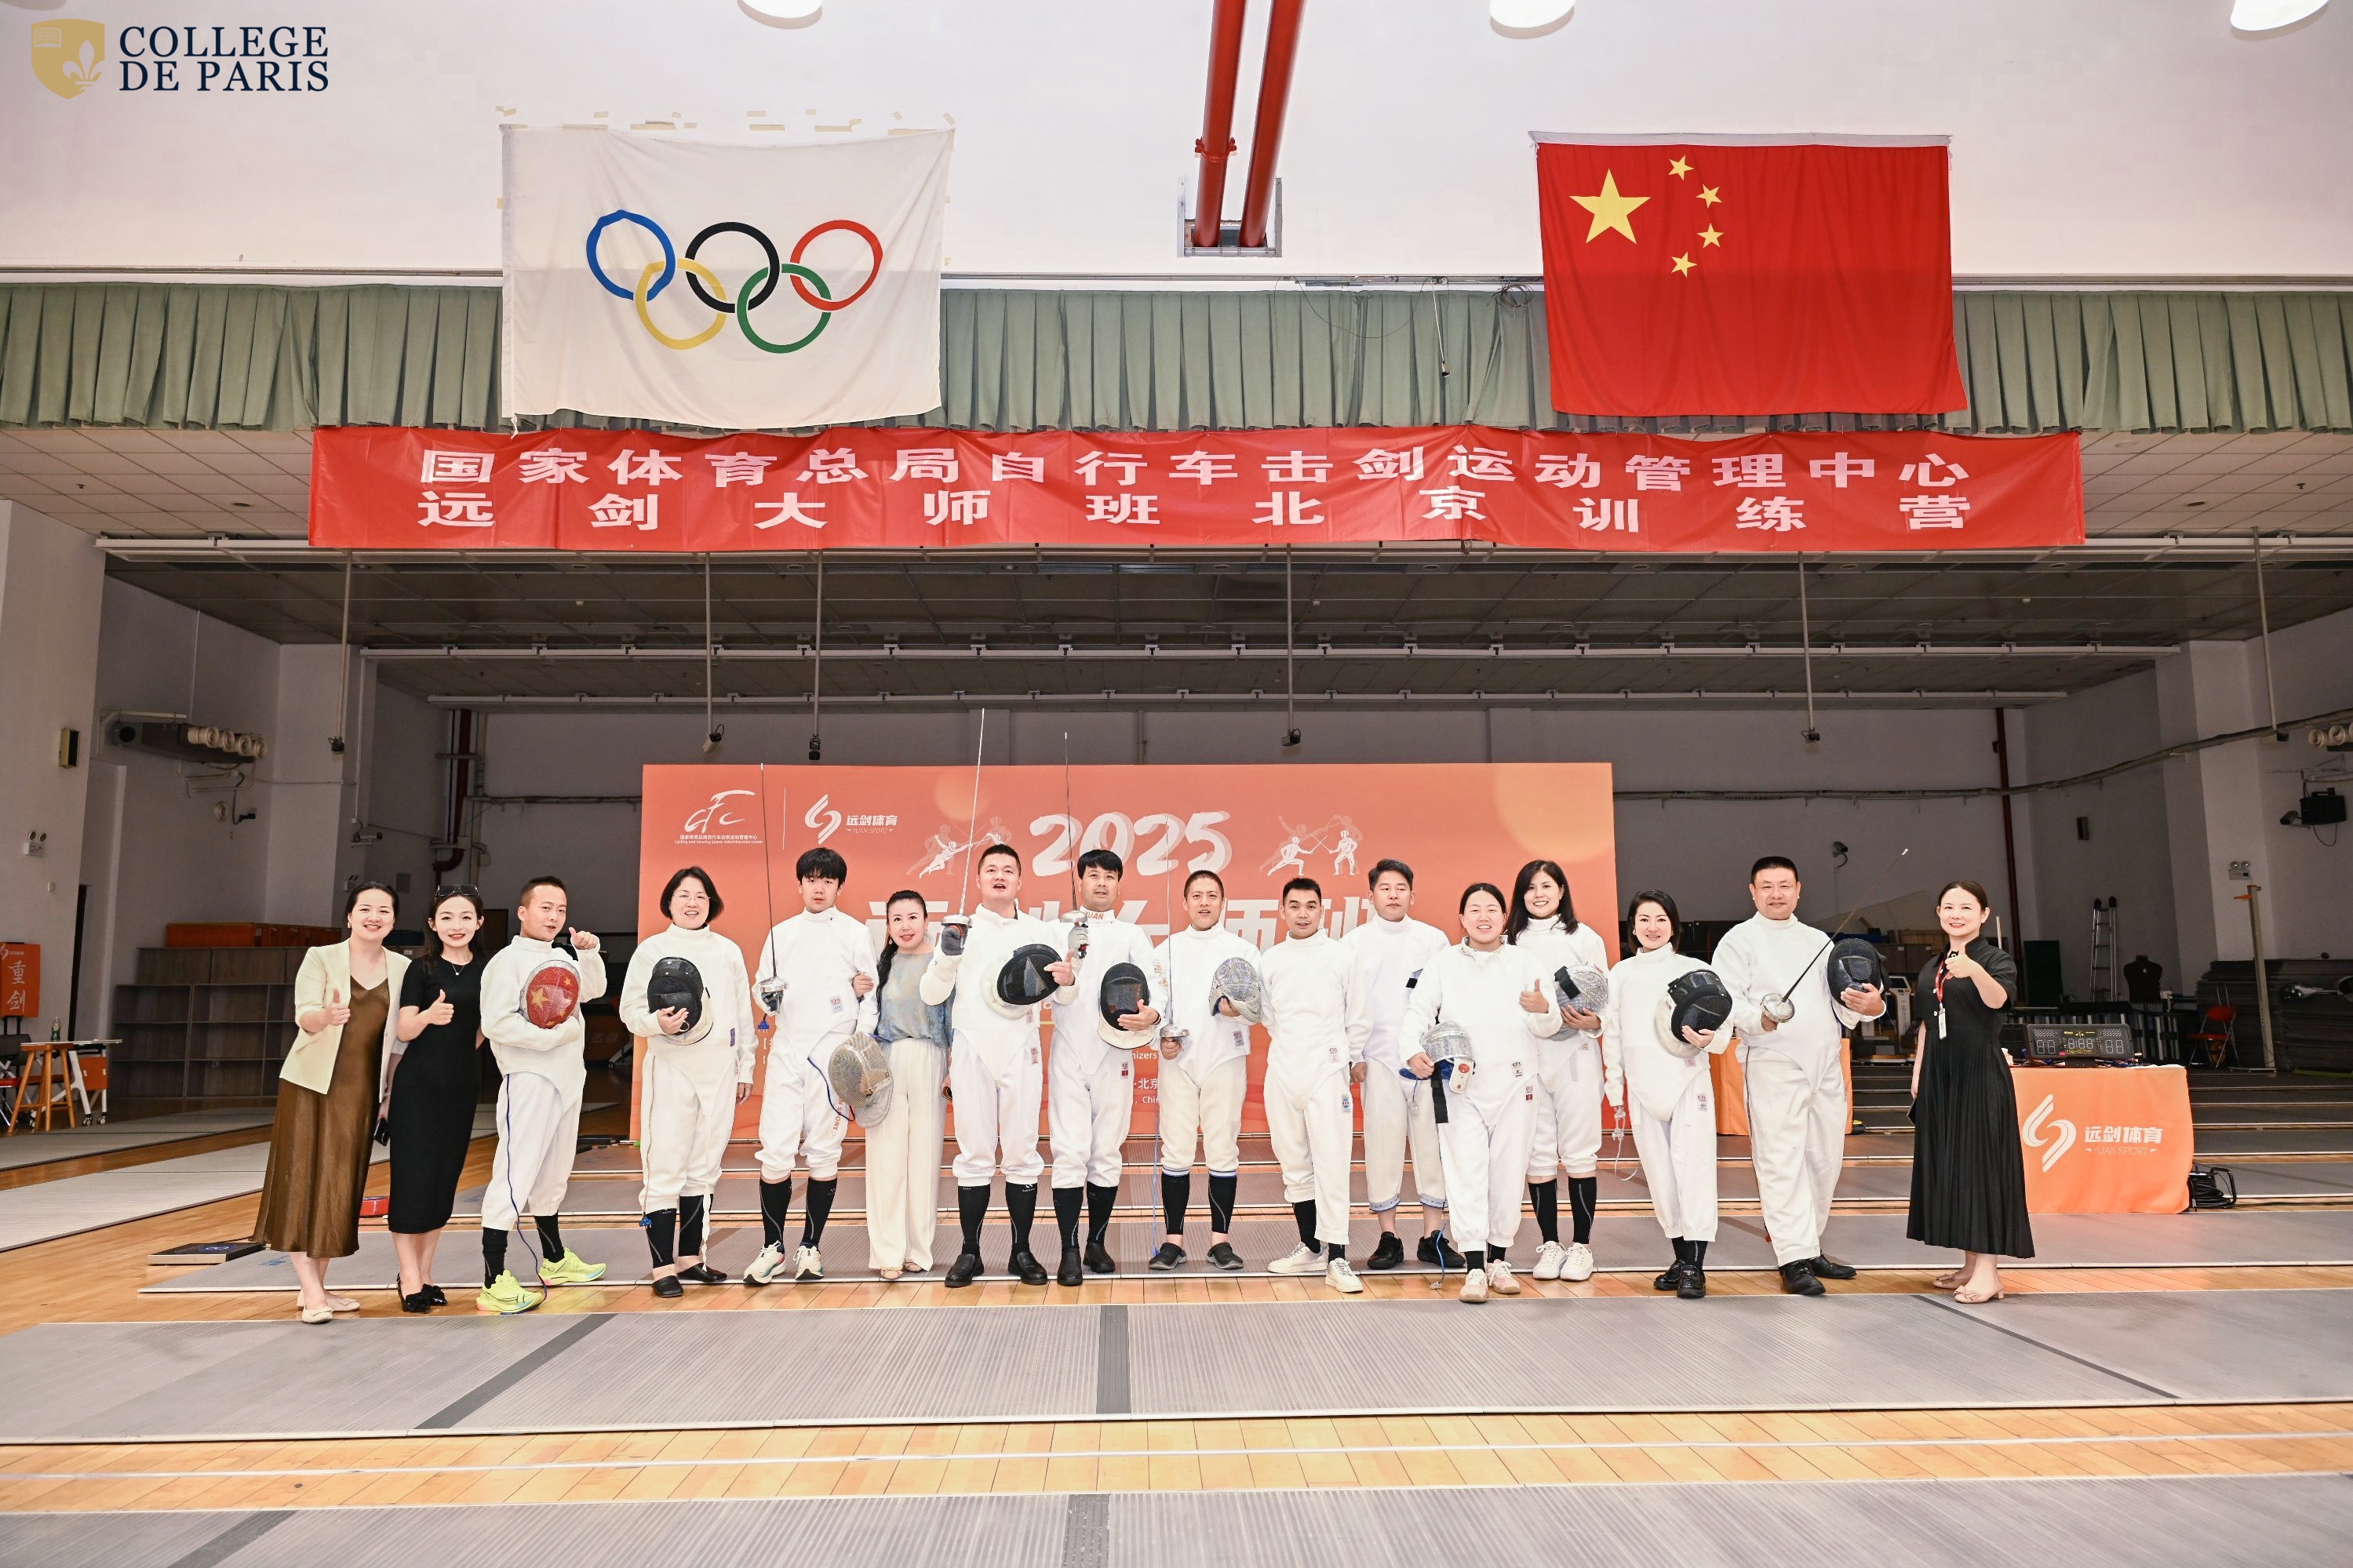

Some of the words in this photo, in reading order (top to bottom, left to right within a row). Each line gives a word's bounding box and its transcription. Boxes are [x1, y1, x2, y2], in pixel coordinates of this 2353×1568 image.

[420, 446, 1969, 492] 国家体育总局自行车击剑运动管理中心
[417, 484, 1971, 533] 远剑大师班北京训练营
[846, 815, 898, 827] 远剑体育
[1029, 811, 1232, 877] 2025
[7, 960, 27, 1013] 重剑
[2084, 1126, 2163, 1144] 远剑体育
[2093, 1146, 2116, 1155] YUAN
[2118, 1146, 2148, 1156] SPORT
